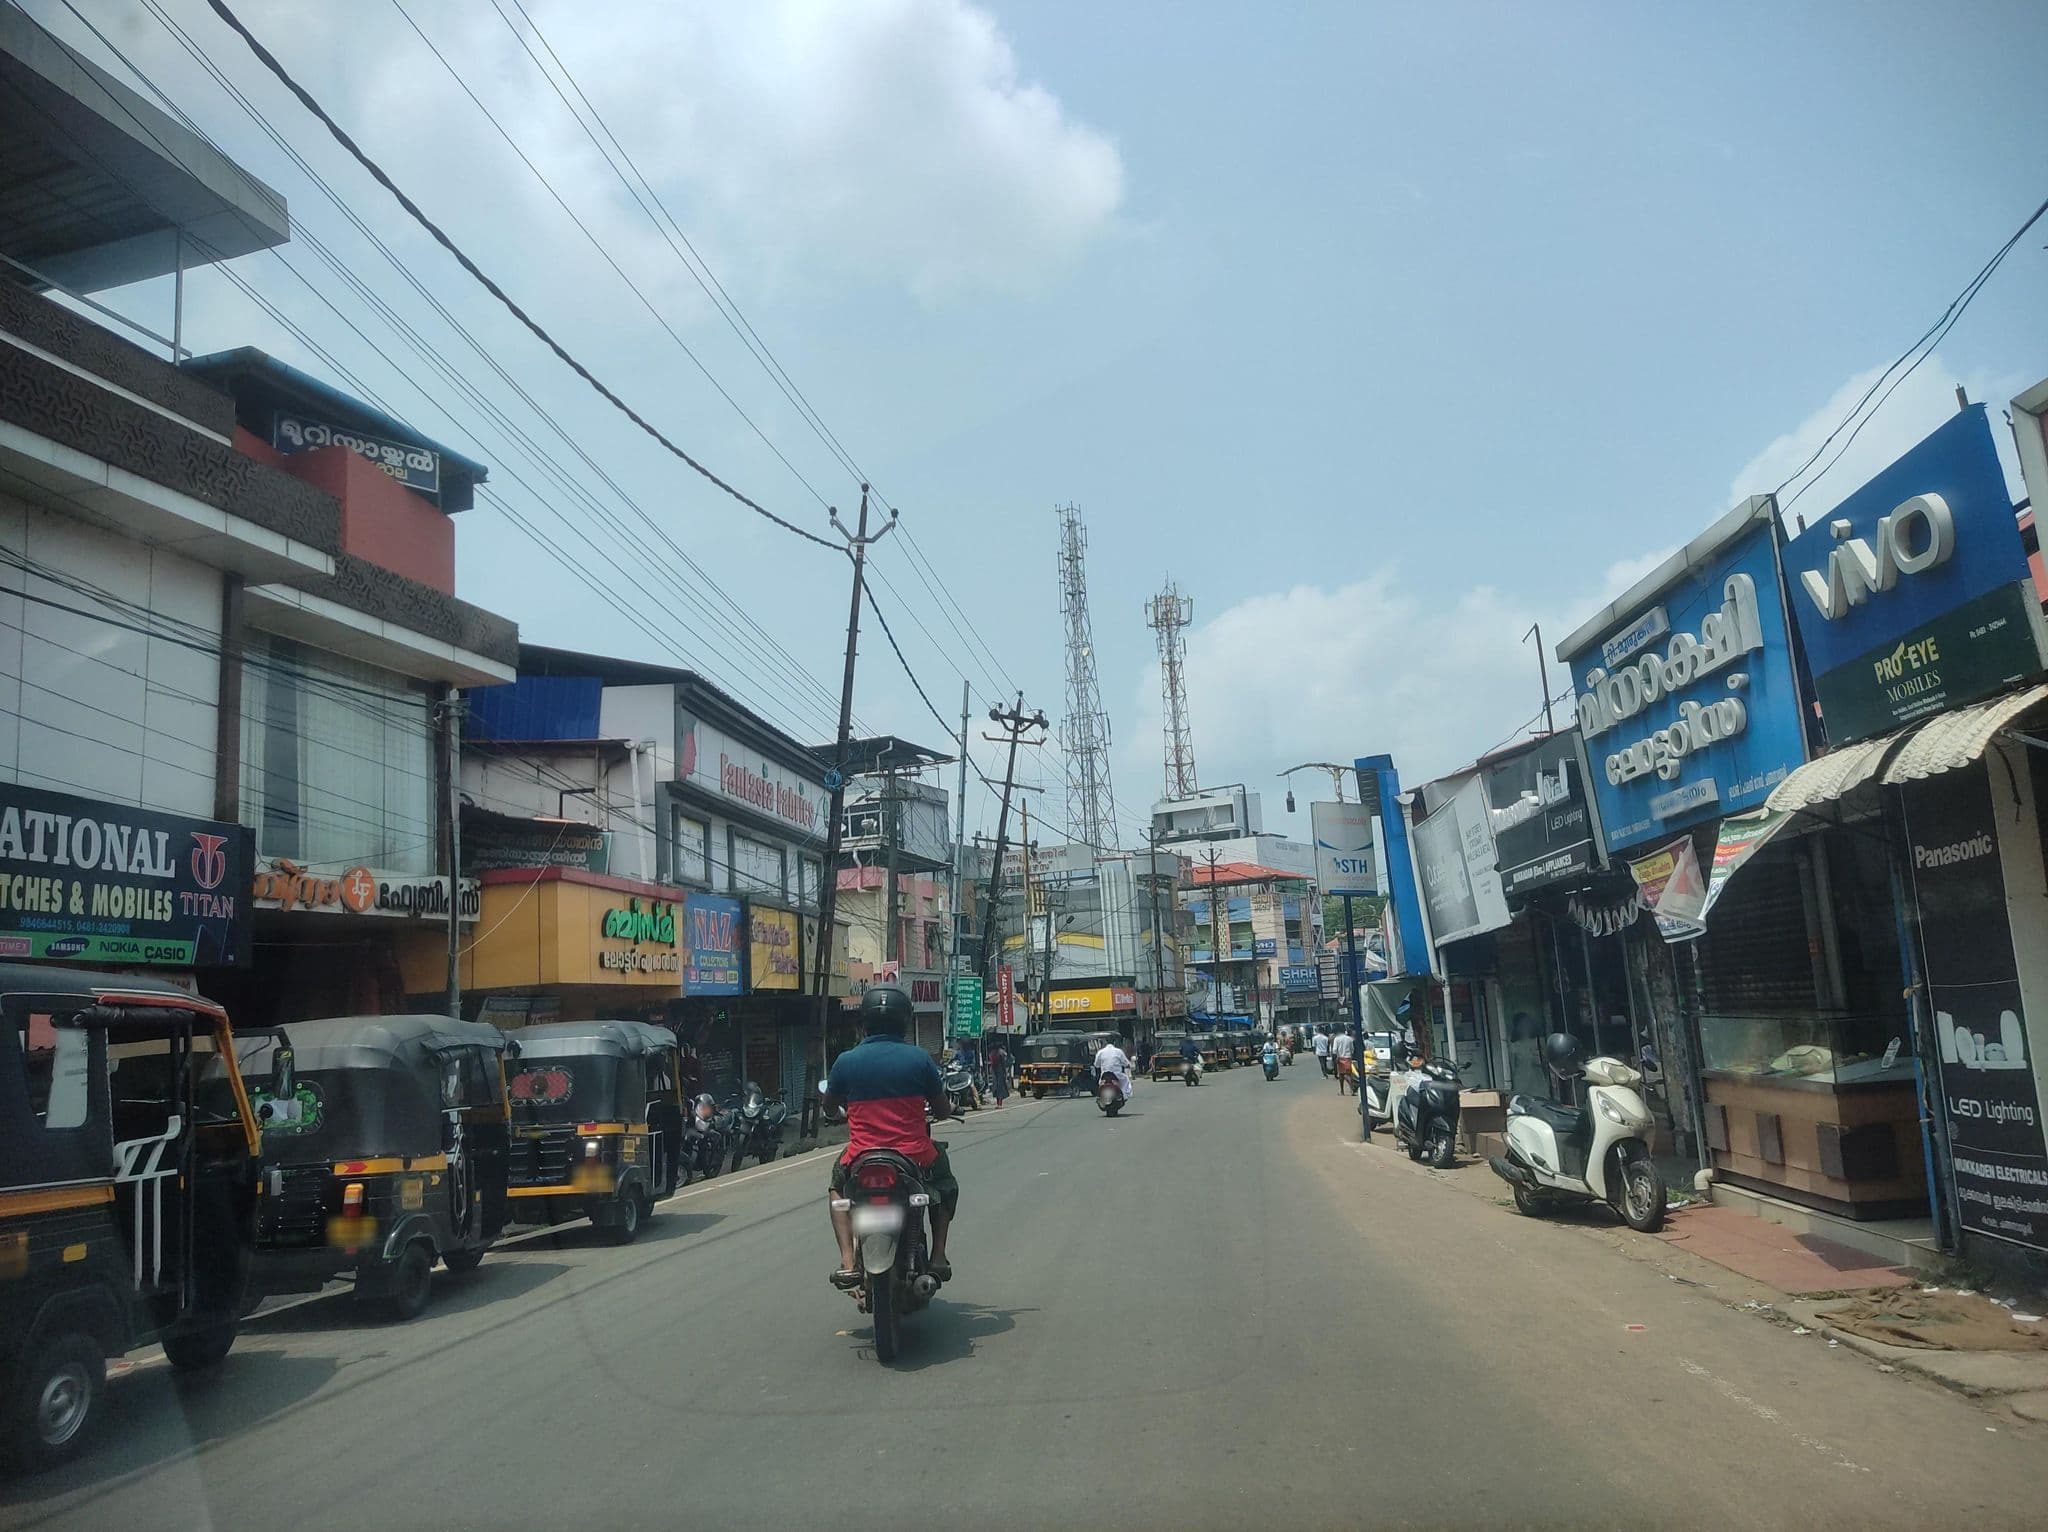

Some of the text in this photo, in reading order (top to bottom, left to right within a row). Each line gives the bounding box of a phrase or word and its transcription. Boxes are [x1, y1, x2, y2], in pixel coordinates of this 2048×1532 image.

[1801, 493, 1955, 621] vivo
[1887, 670, 1941, 704] MOBILES
[1914, 831, 1993, 869] Panasonic
[70, 880, 84, 915] &
[91, 883, 173, 922] MOBILES
[180, 890, 234, 920] TITAN
[694, 908, 732, 953] NAZ
[51, 943, 86, 952] SAMSUNG
[101, 940, 140, 954] NOKIA
[144, 946, 186, 961] CASIO
[1282, 968, 1317, 980] SHAH
[1950, 1096, 2034, 1126] LED Lighting
[1997, 1164, 2048, 1186] ELECTRICALS
